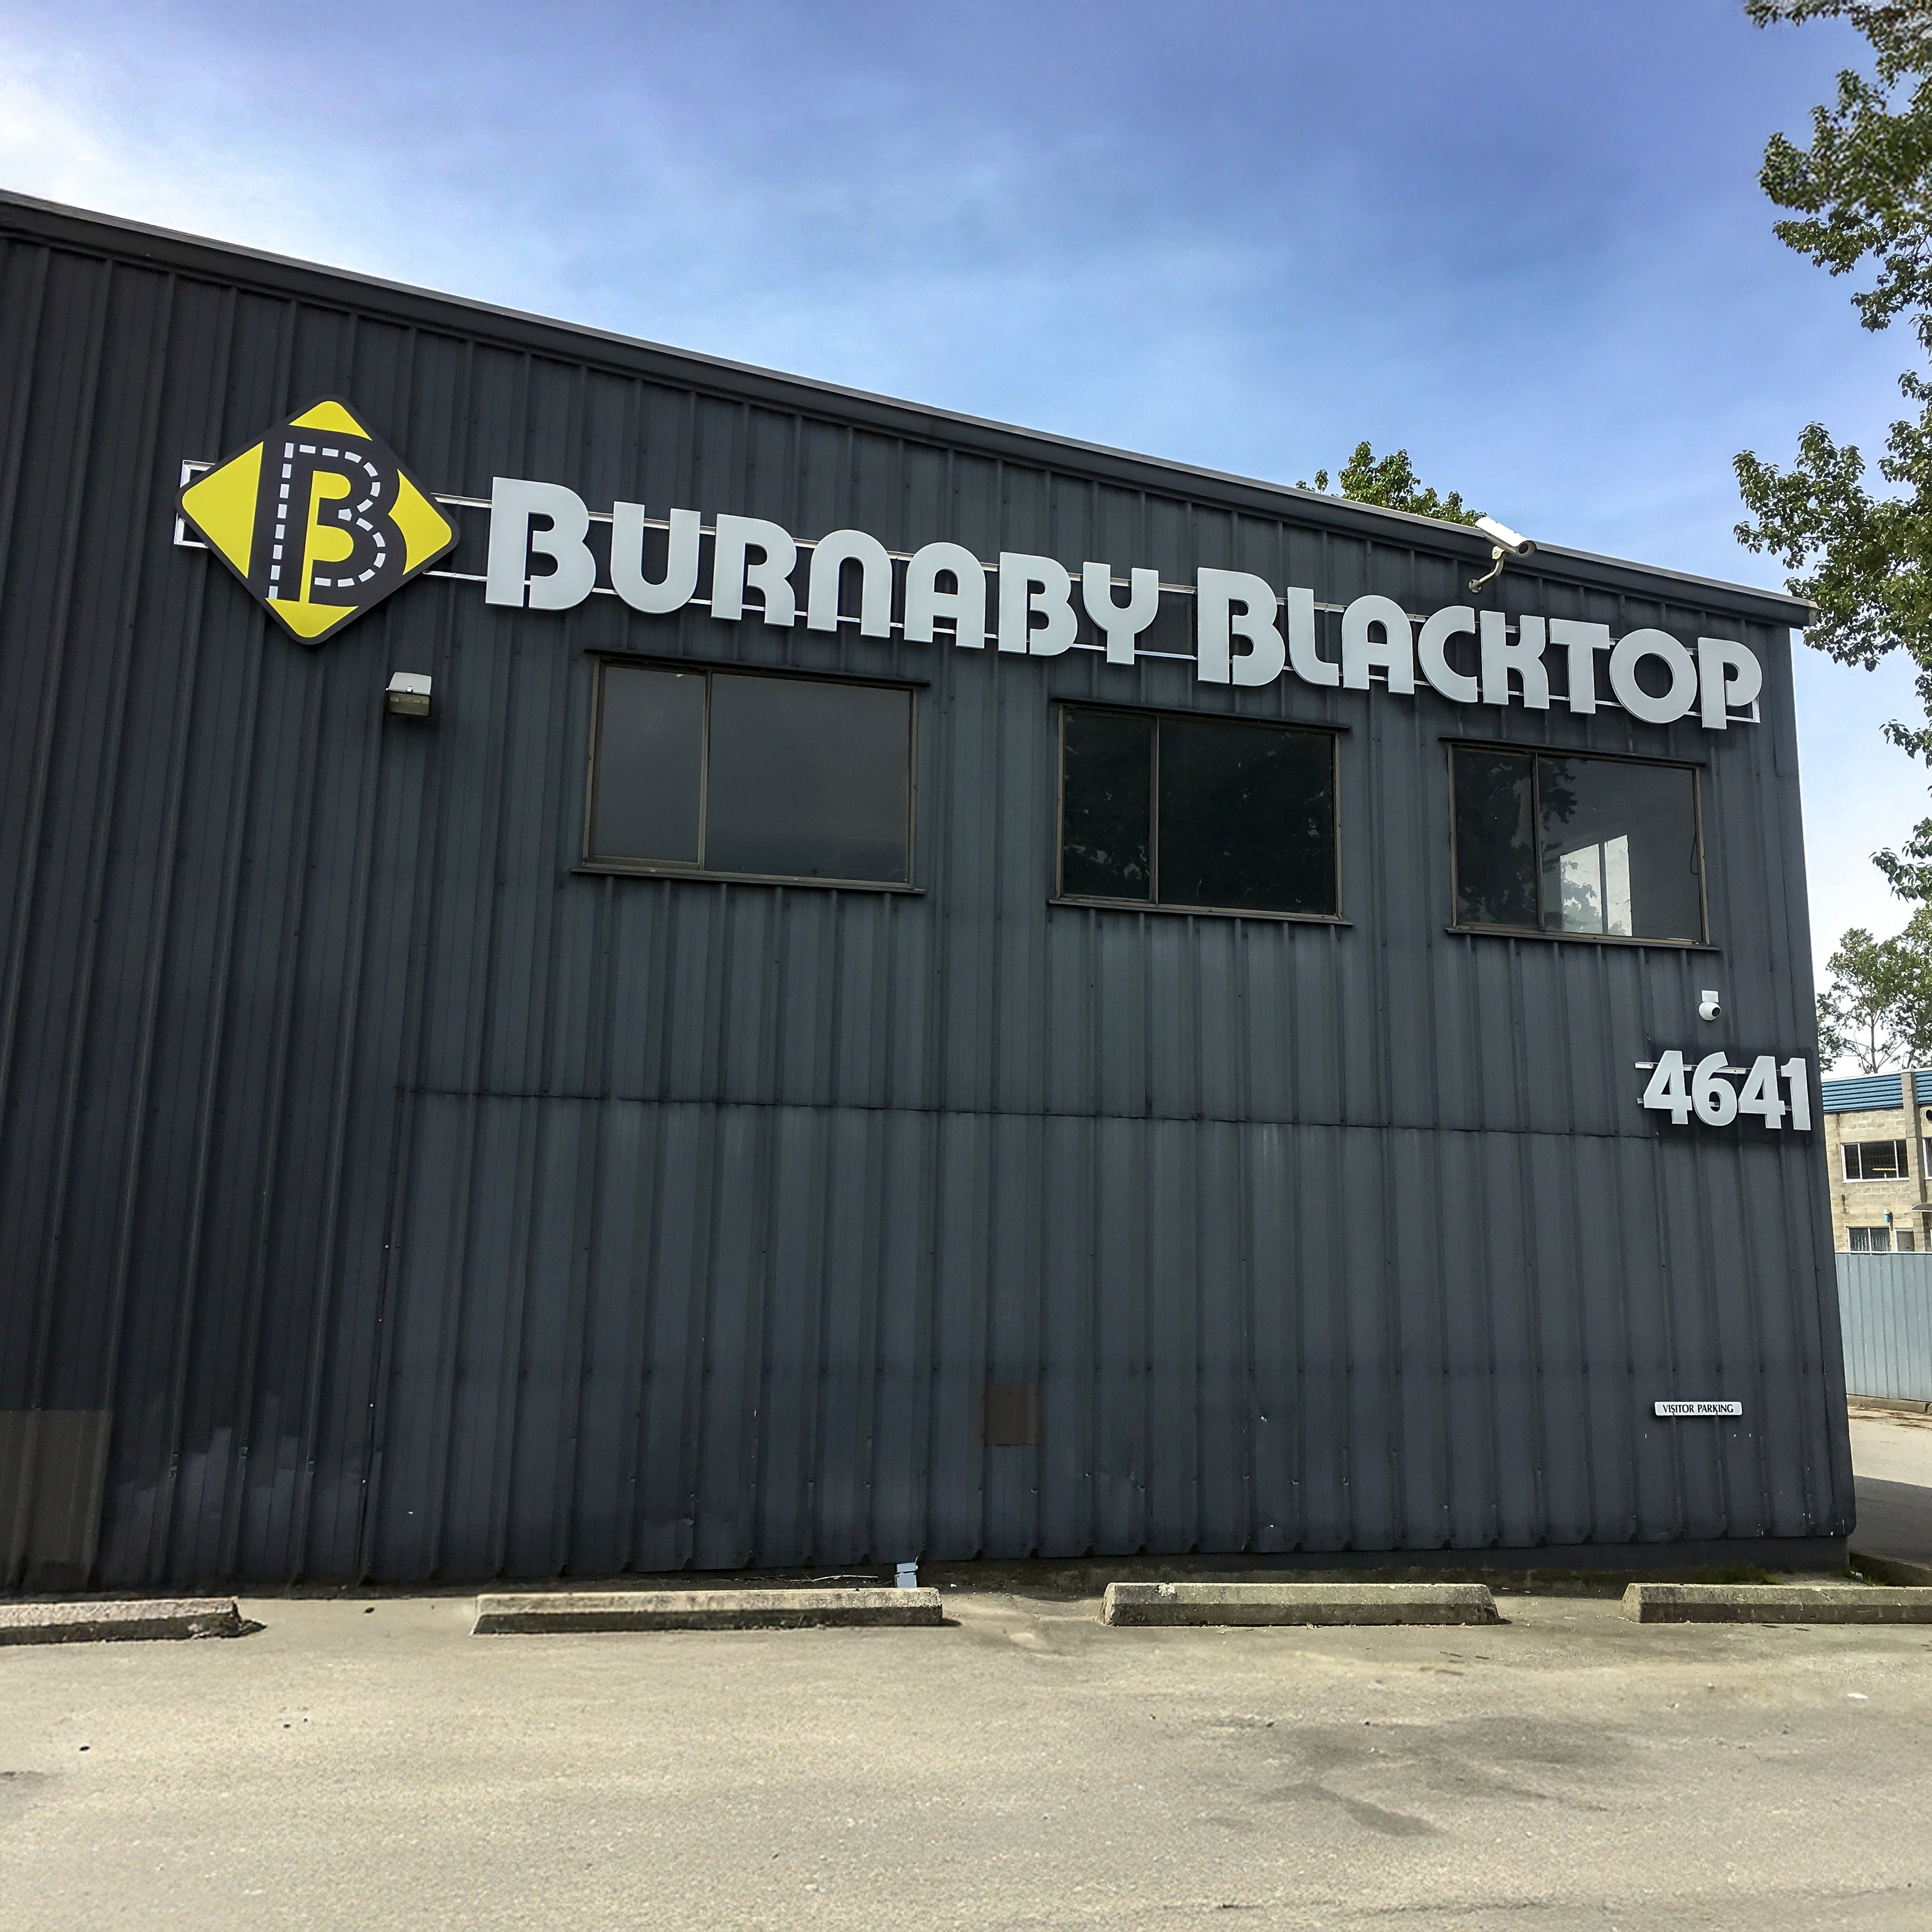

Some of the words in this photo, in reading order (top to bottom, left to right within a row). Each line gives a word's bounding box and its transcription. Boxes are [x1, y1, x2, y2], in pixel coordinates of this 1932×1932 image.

[485, 477, 1160, 665] BURNABY
[1197, 567, 1763, 730] BLACKTOP
[1643, 1050, 1811, 1131] 4641
[1663, 1404, 1694, 1413] VISITOR
[1697, 1404, 1733, 1413] PARKING
